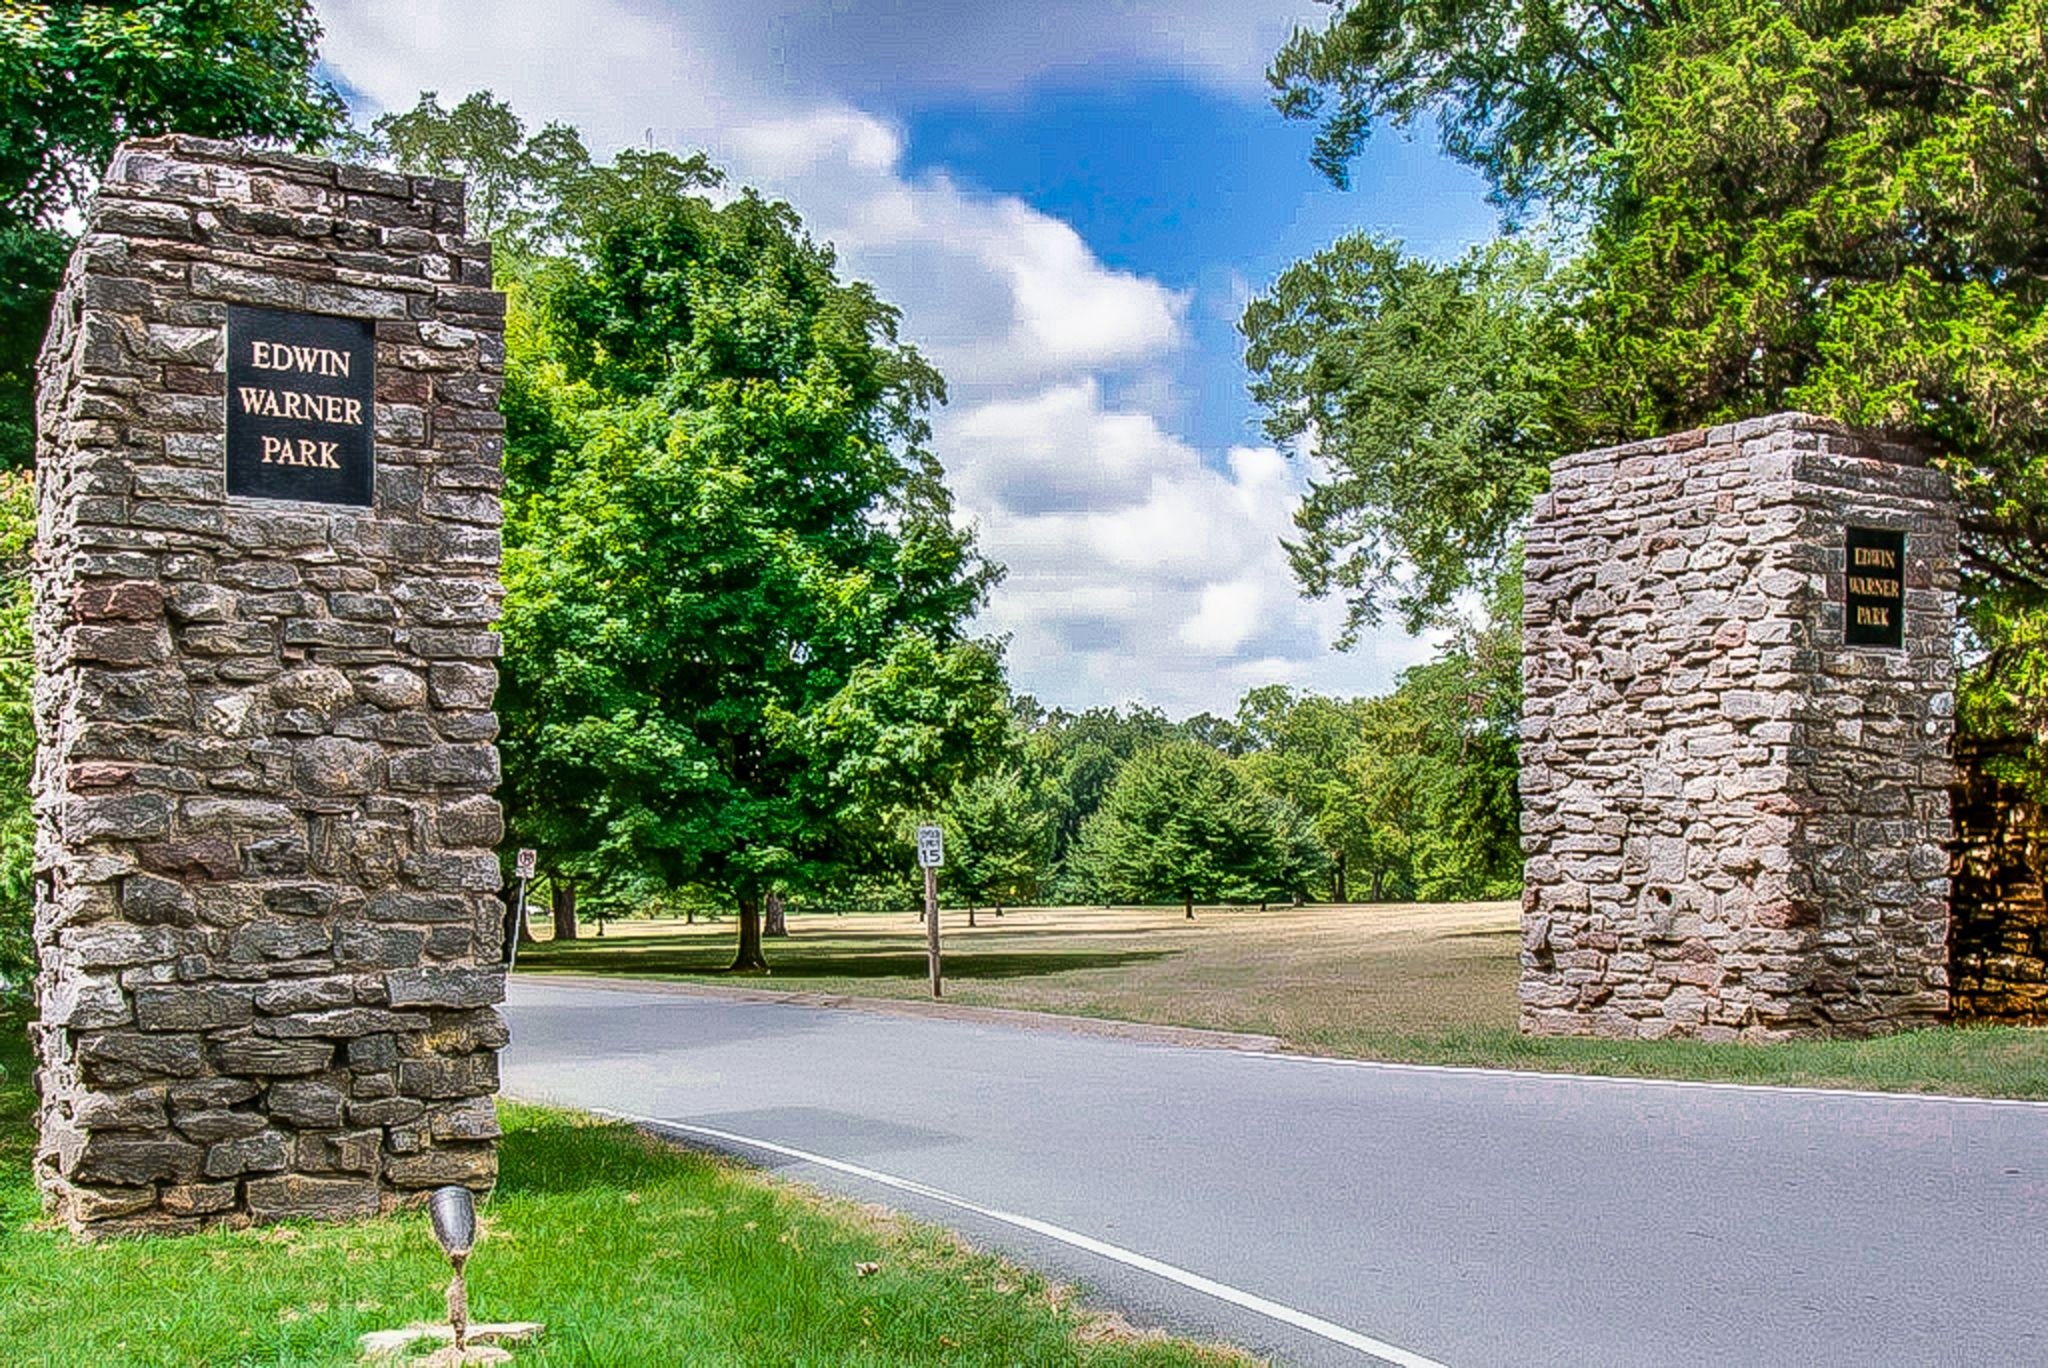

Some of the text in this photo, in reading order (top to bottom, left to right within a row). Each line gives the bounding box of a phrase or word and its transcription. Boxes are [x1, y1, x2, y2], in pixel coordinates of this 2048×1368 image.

[252, 341, 350, 378] EDWIN
[238, 387, 363, 425] WARNER
[261, 435, 341, 469] PARK
[1849, 576, 1899, 598] WARNER
[1857, 605, 1889, 627] PARK
[922, 850, 940, 862] 15
